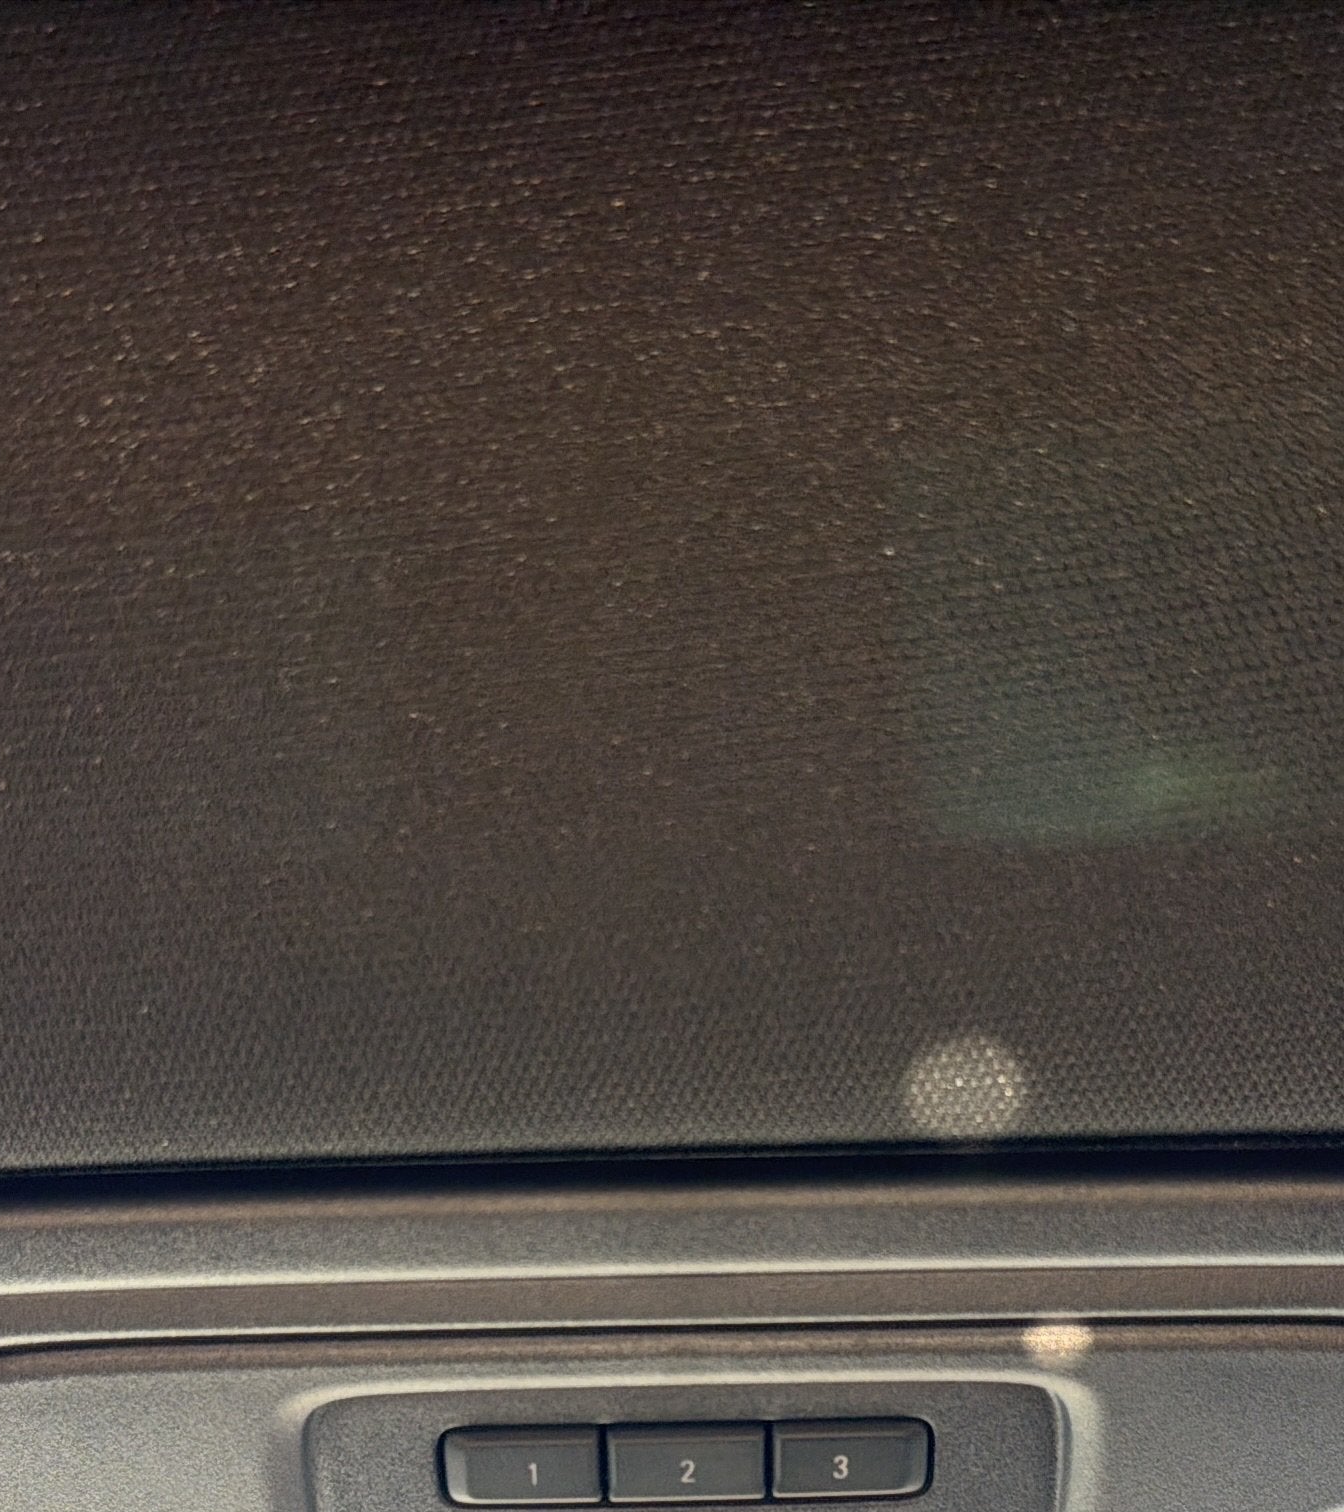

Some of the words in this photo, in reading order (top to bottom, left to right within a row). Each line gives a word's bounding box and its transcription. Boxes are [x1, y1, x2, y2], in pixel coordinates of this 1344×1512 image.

[528, 1462, 538, 1487] 1
[680, 1459, 696, 1484] 2
[832, 1454, 849, 1480] 3
